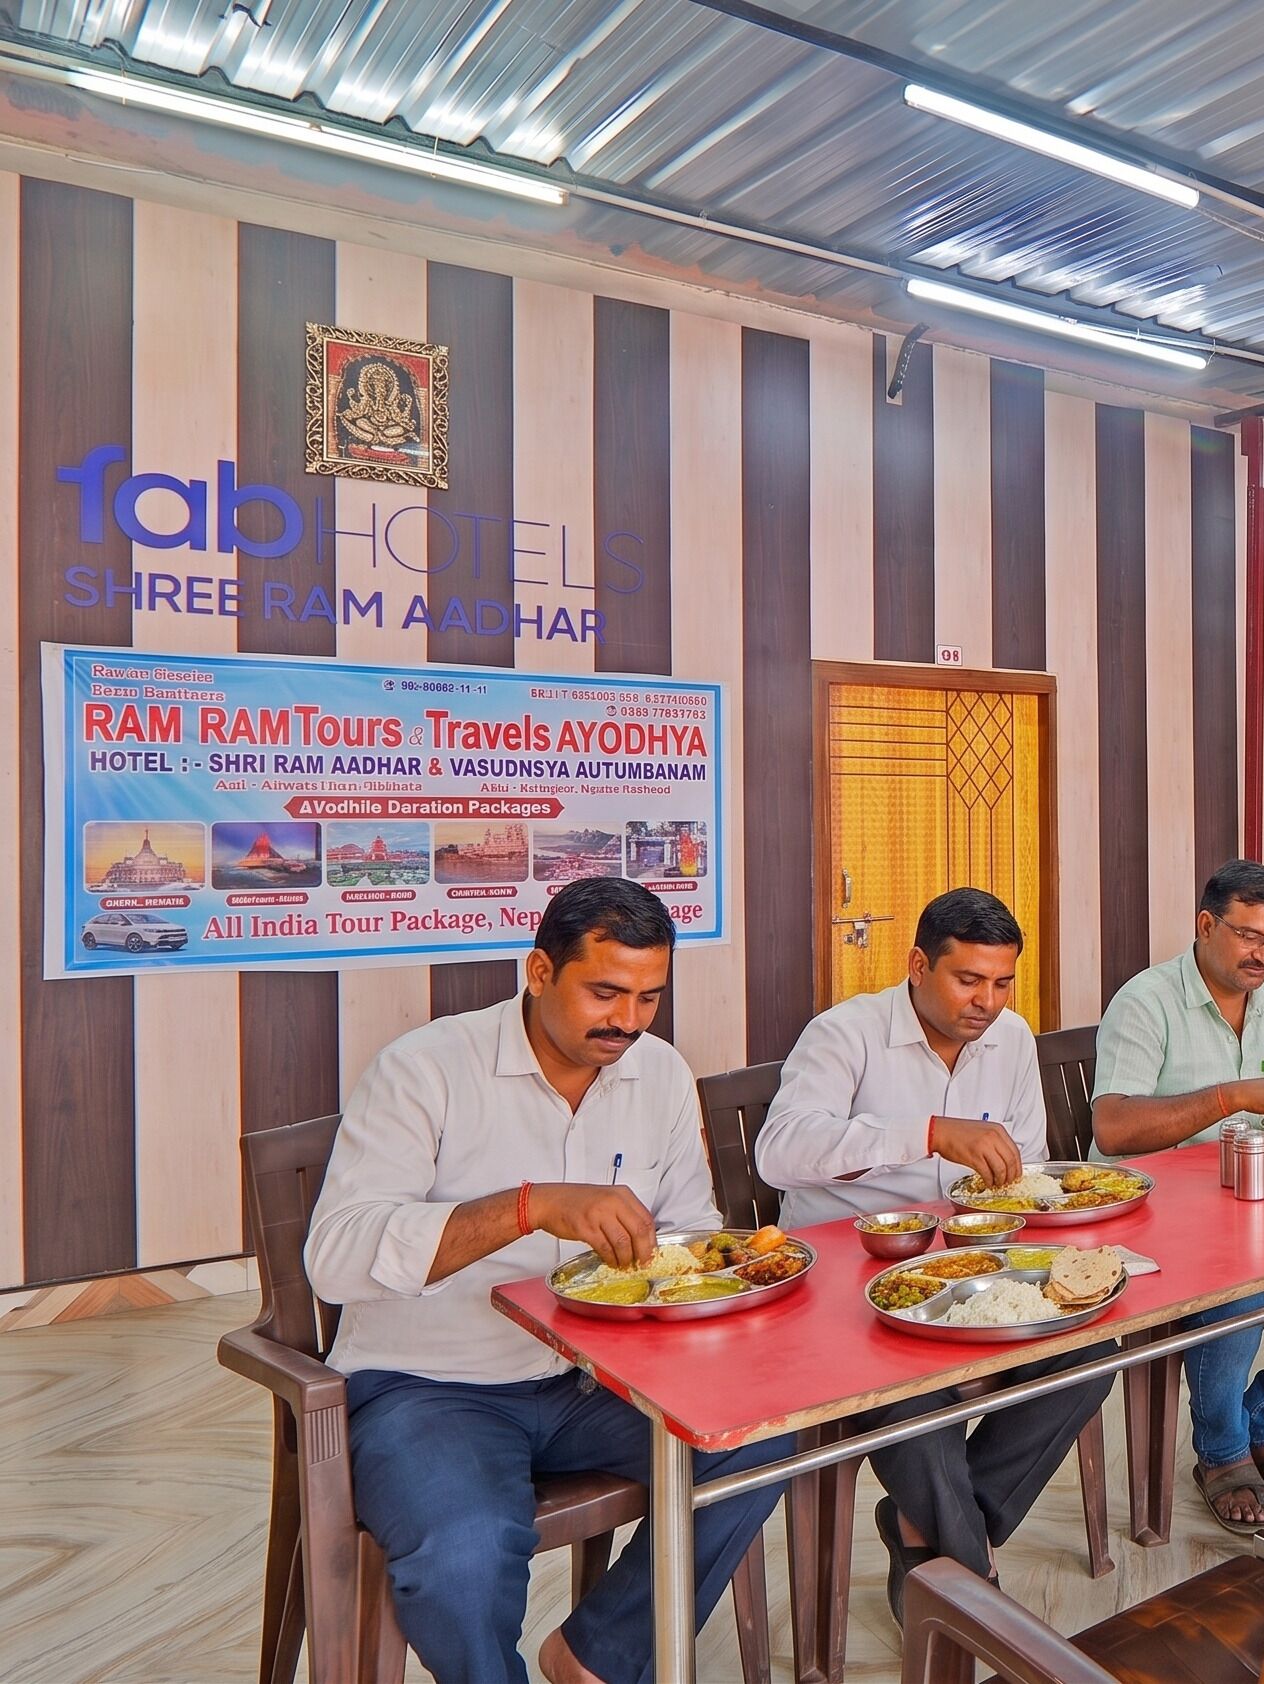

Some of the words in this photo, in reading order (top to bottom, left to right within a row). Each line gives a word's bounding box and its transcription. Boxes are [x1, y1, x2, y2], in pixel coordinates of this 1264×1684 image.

[63, 565, 246, 618] SHREE
[263, 581, 383, 628] RAM
[402, 594, 607, 645] AADHAR
[84, 703, 182, 743] RAM
[409, 727, 424, 745] &
[426, 710, 550, 752] Travels
[556, 720, 708, 757] AYODHYA
[90, 751, 173, 772] HOTEL
[208, 753, 265, 773] SHRI
[274, 755, 324, 774] RAM
[331, 756, 422, 775] AADHAR
[428, 757, 443, 776] &
[449, 757, 570, 778] VASUDNSYA
[575, 761, 706, 780] AUTUMBANAM
[388, 799, 463, 815] Daration
[469, 800, 551, 817] Packages
[203, 915, 243, 939] All
[250, 913, 319, 938] India
[325, 912, 384, 934] Tour
[390, 909, 493, 934] Package,
[499, 907, 542, 932] Nep
[668, 903, 703, 924] age
